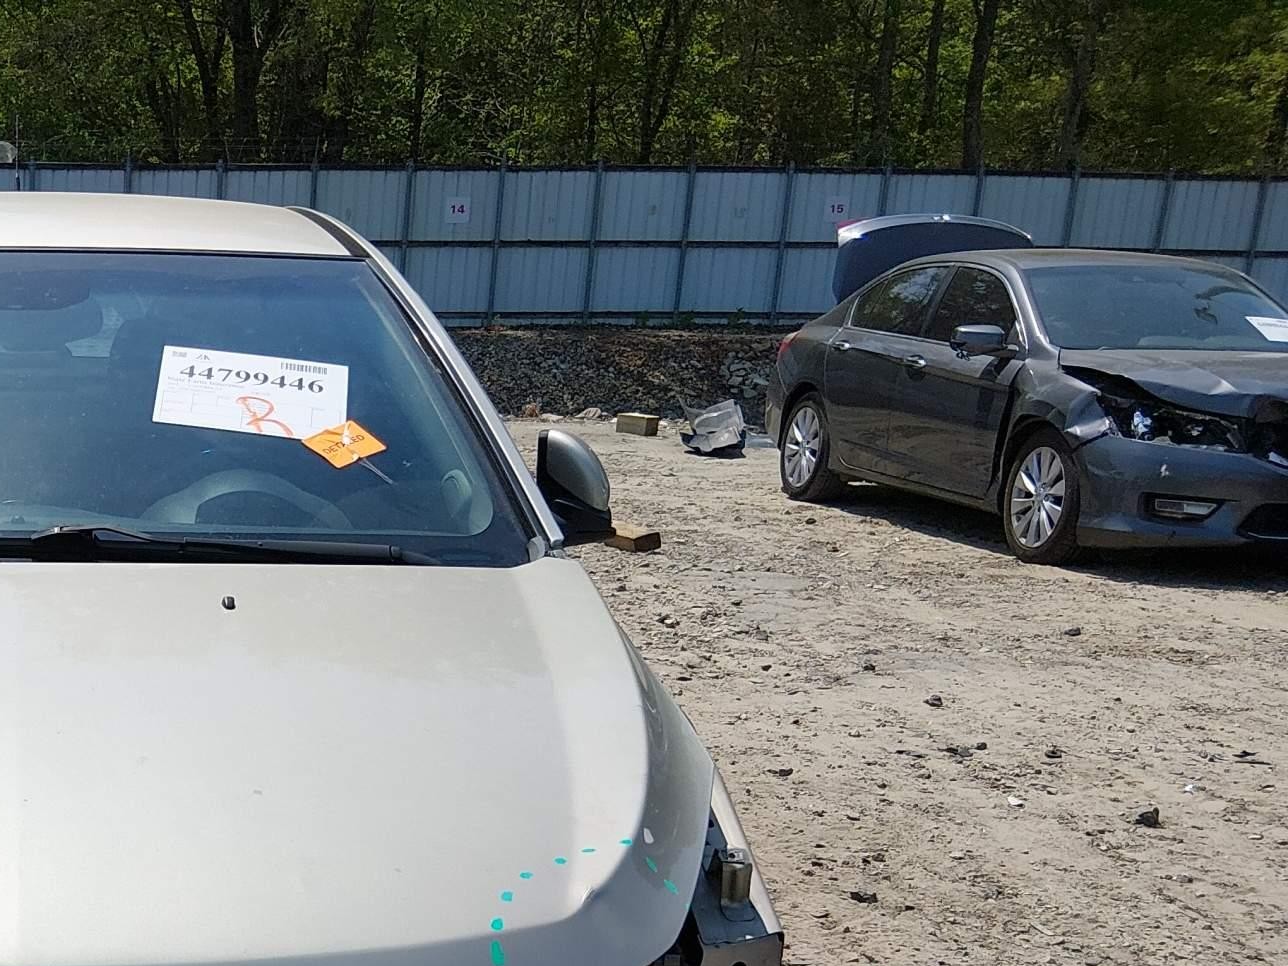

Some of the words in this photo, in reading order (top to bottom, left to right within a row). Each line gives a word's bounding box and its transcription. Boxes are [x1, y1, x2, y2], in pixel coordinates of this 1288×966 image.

[450, 204, 465, 214] 14
[830, 204, 844, 214] 15
[180, 364, 324, 394] 44799446
